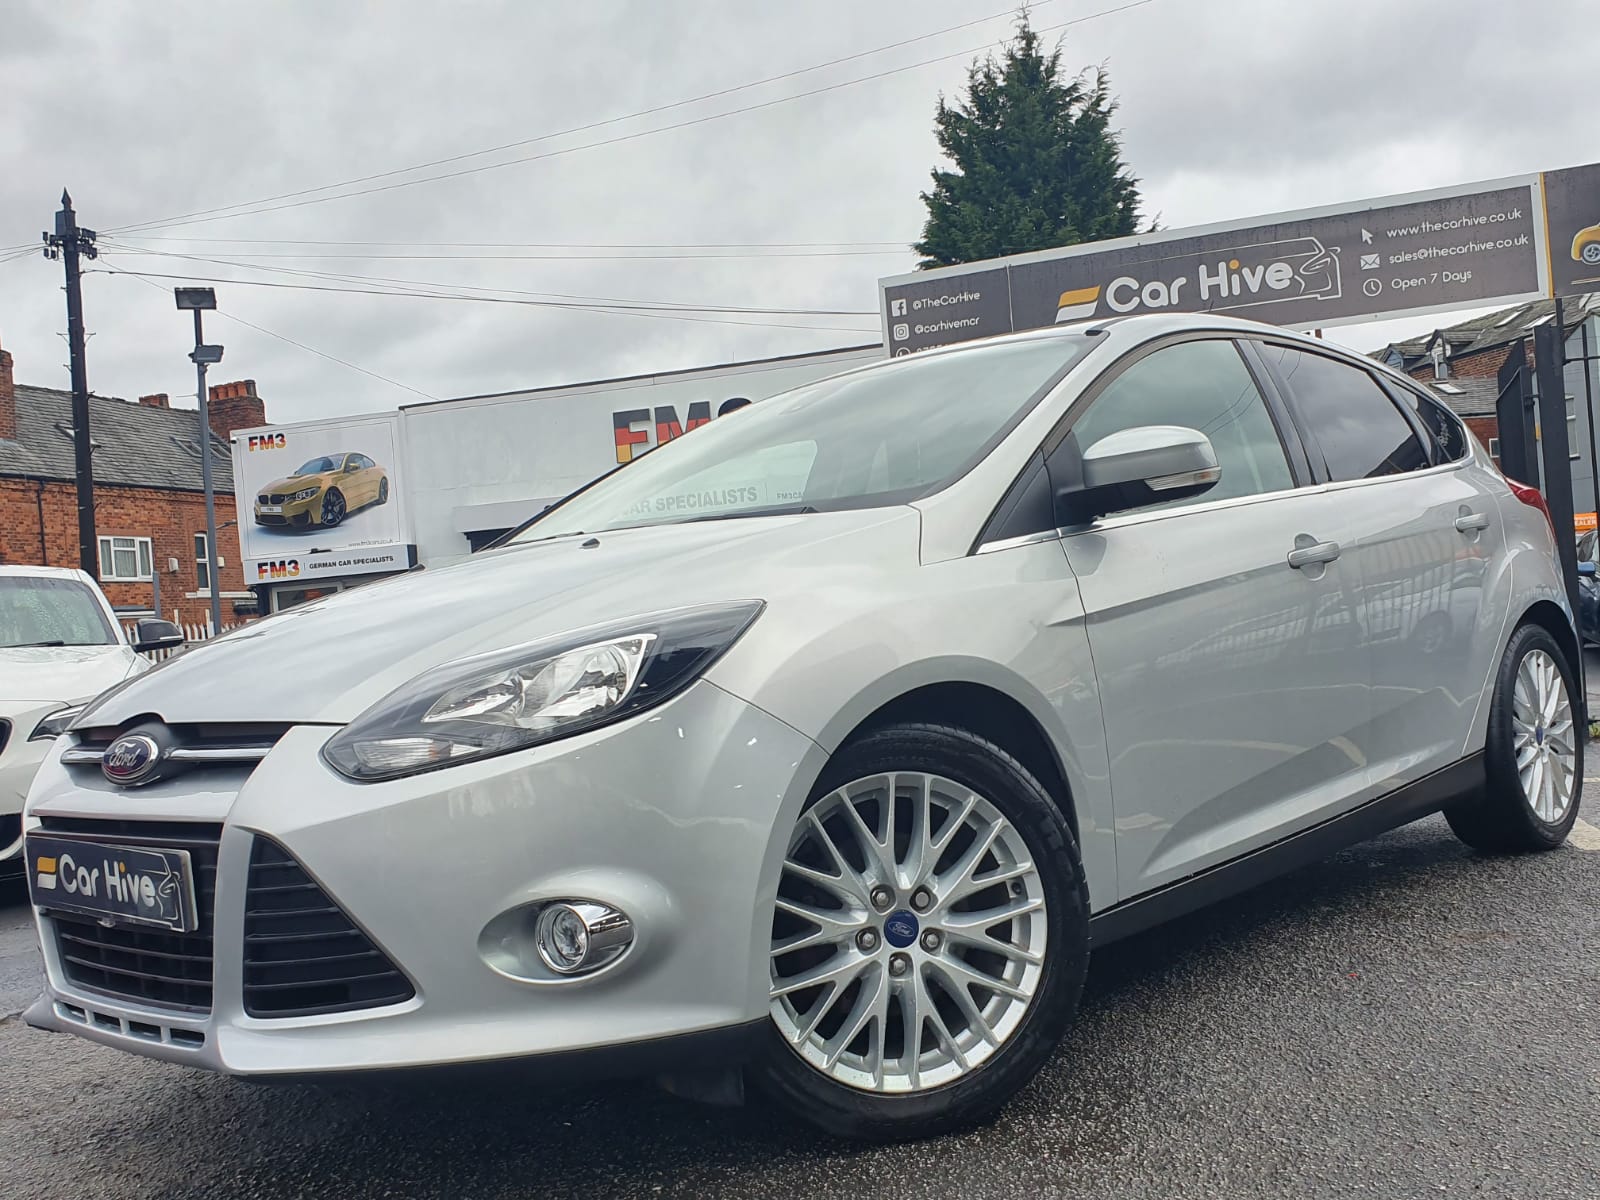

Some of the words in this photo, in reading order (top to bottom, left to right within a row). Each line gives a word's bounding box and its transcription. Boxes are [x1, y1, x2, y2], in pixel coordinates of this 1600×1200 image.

[1386, 207, 1522, 238] www.thecarhive.co.uk
[1389, 233, 1529, 264] sales@thecarhive.co.uk
[1106, 276, 1187, 313] Car
[1199, 259, 1293, 300] Hive
[1391, 277, 1427, 291] Open
[1430, 273, 1438, 284] 7
[1442, 269, 1472, 283] Days
[912, 291, 981, 310] @TheCarHive
[914, 317, 980, 334] @carhivemcr
[248, 433, 286, 452] FM3
[613, 397, 752, 464] FM
[655, 486, 758, 512] SPECIALISTS
[257, 559, 300, 580] FM3
[309, 561, 337, 569] GERMAN
[338, 559, 352, 567] CAR
[353, 555, 394, 565] SPECIALISTS
[109, 741, 141, 767] Ford
[59, 853, 99, 898] Car
[103, 859, 156, 907] Hive
